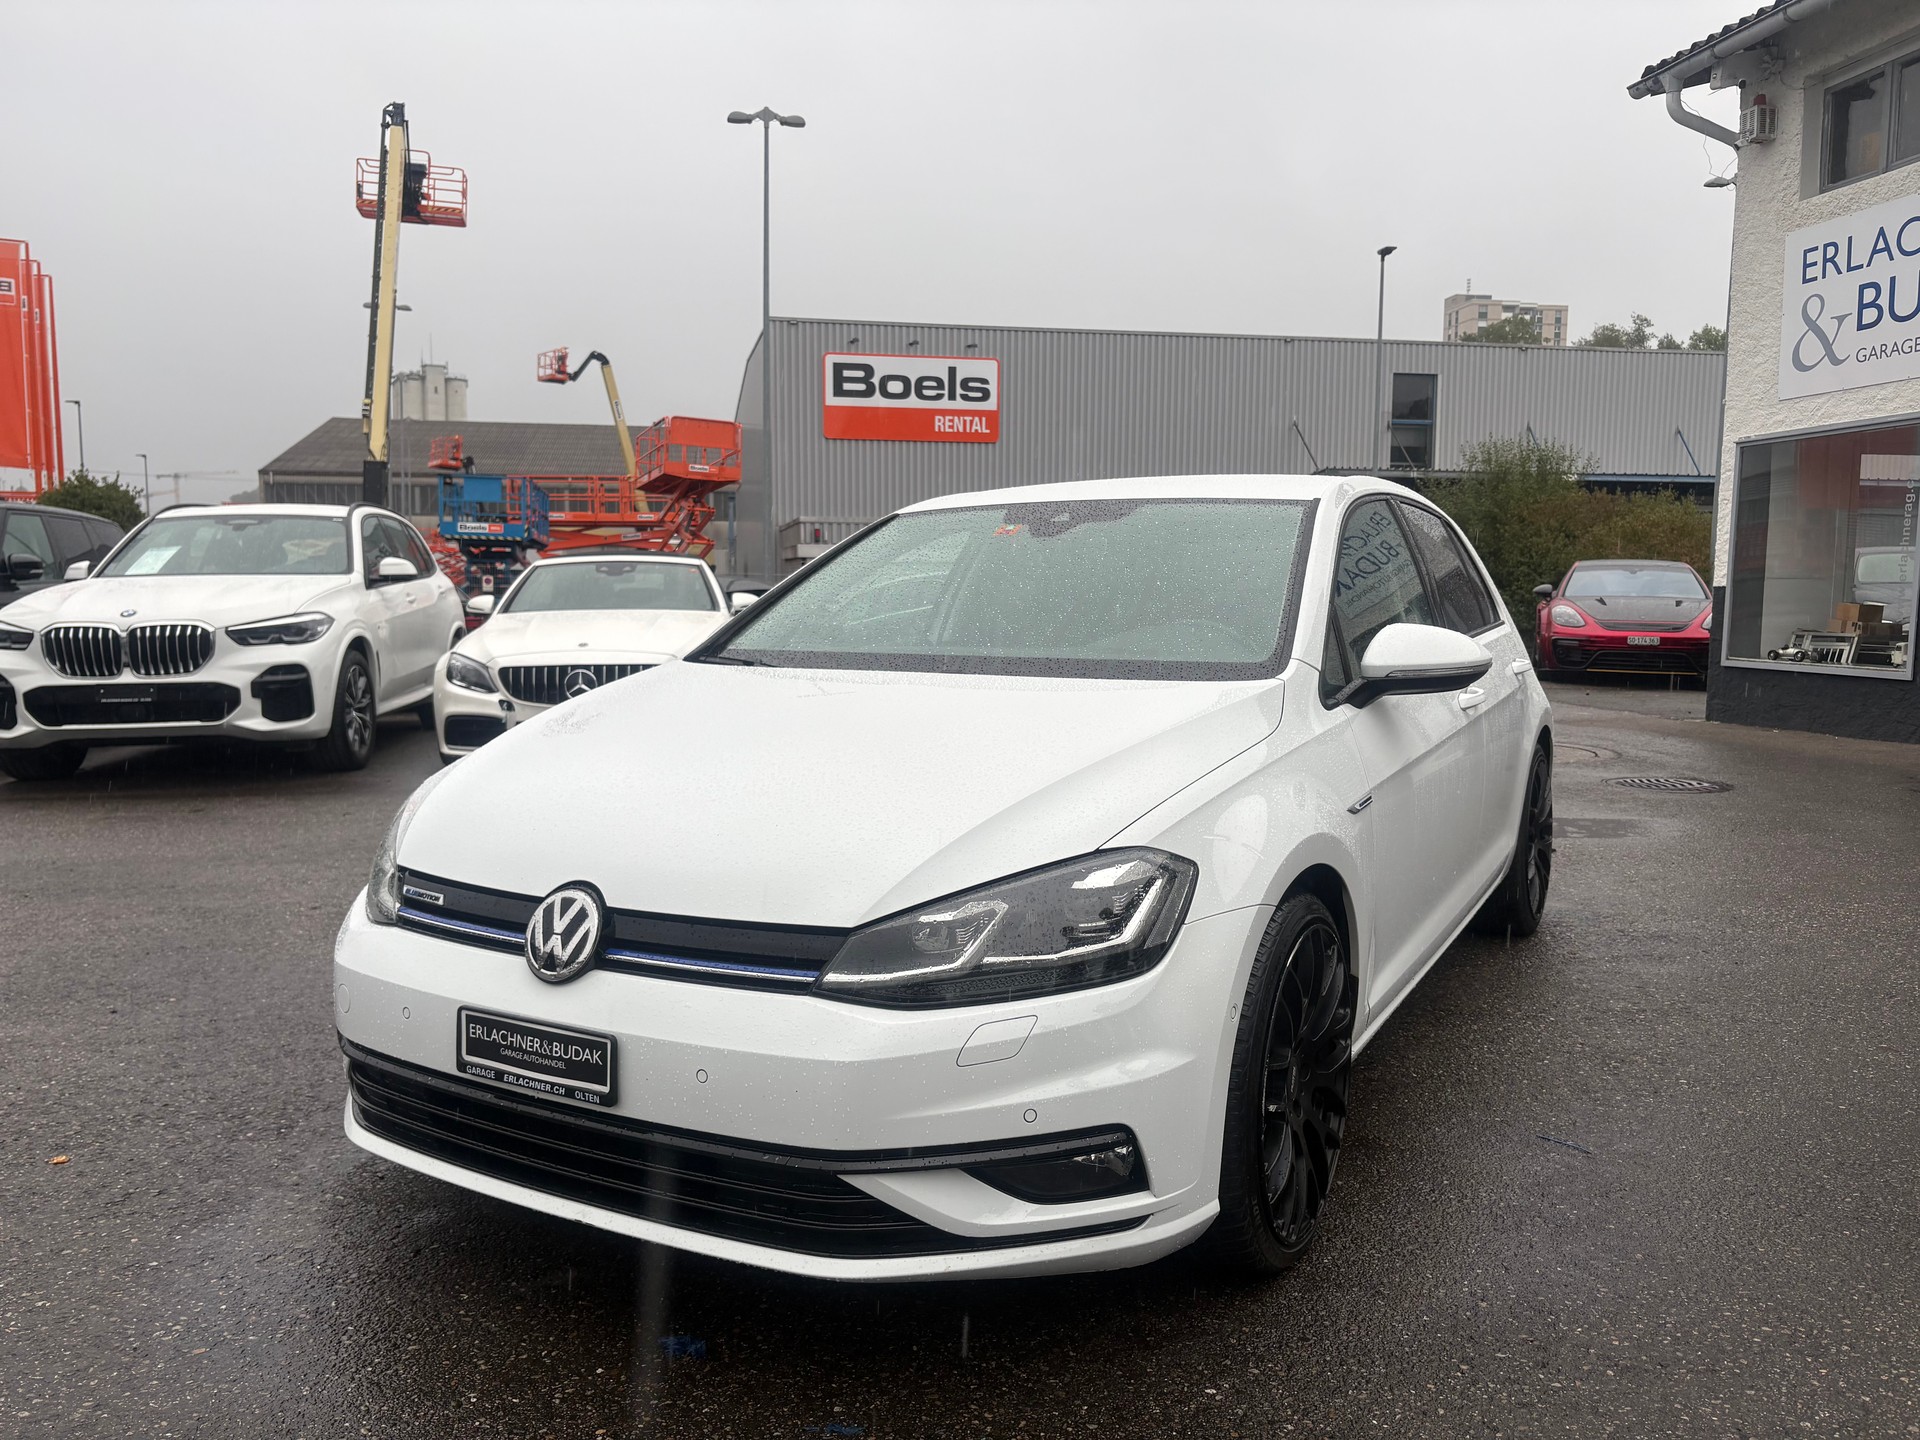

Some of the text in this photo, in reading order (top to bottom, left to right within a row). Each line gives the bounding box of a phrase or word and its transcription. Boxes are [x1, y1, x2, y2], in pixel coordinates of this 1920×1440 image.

[1802, 216, 1920, 284] ERLAC
[1792, 293, 1853, 372] &
[1855, 336, 1920, 363] GARAGE
[832, 362, 991, 402] Boels
[934, 415, 990, 433] RENTAL
[500, 1047, 566, 1069] GARAGE AUTOHANDEL
[466, 1065, 600, 1104] GARAGE ERLACHNER.CH OLTEN
